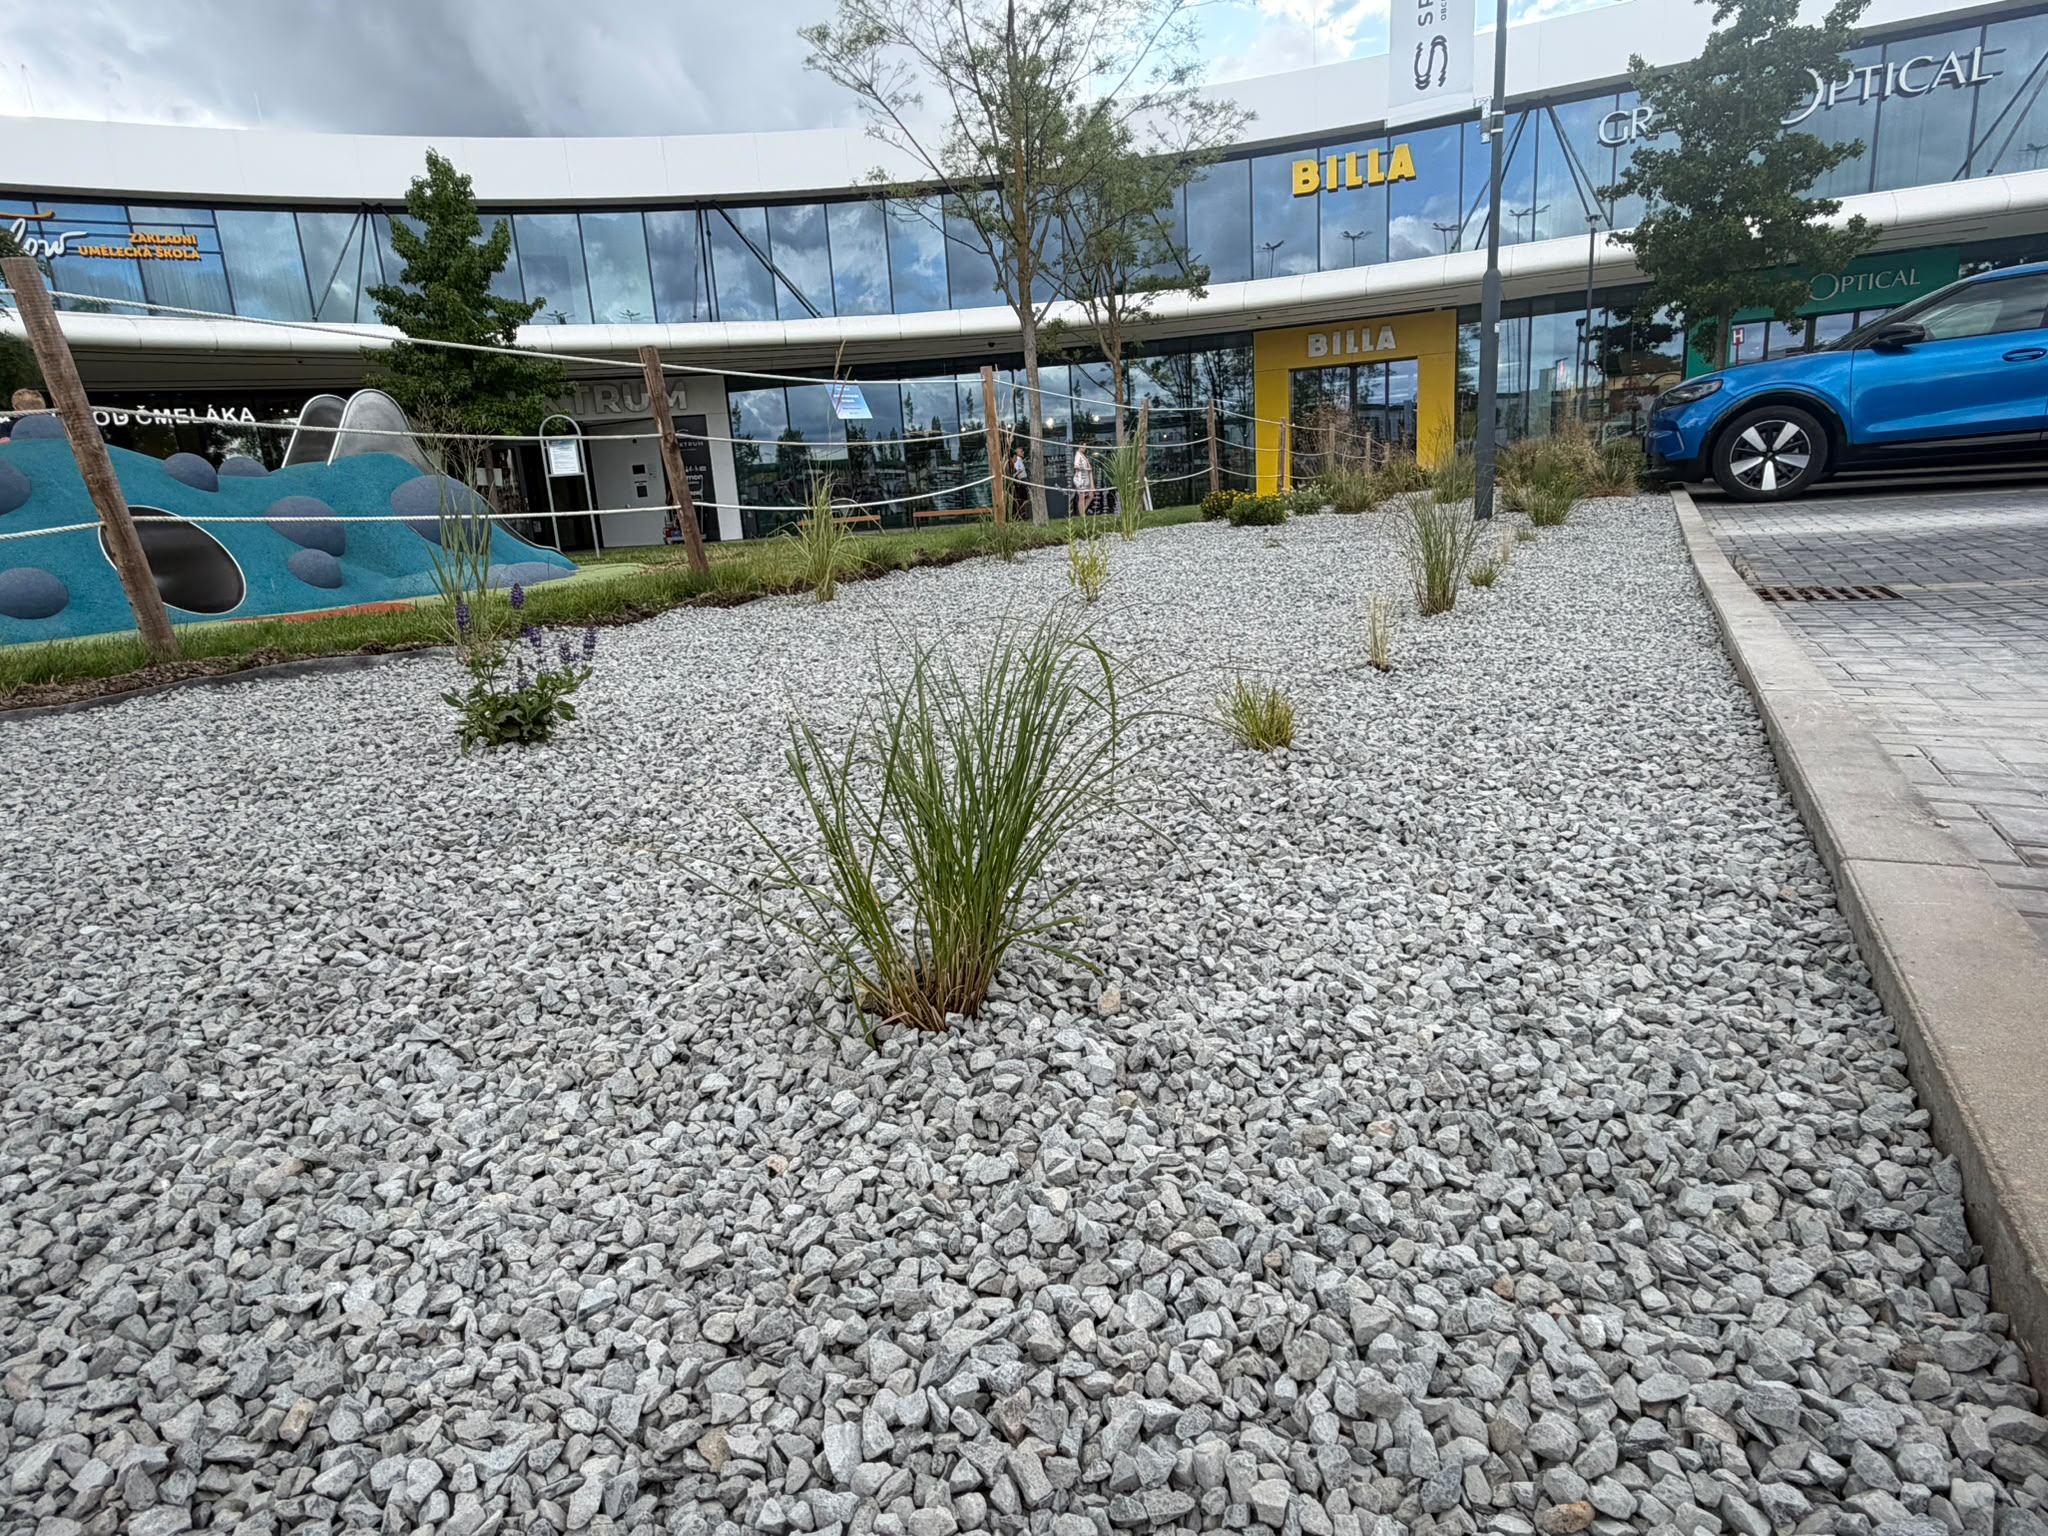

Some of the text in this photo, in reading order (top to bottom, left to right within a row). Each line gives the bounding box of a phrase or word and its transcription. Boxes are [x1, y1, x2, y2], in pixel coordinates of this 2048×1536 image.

[1292, 143, 1416, 196] BILLA
[129, 231, 197, 246] ZÁKLADNÍ
[78, 244, 201, 260] UMĚLECKÁ ŠKOLA
[1308, 326, 1397, 358] BILLA
[136, 404, 256, 425] ČMELÁKA
